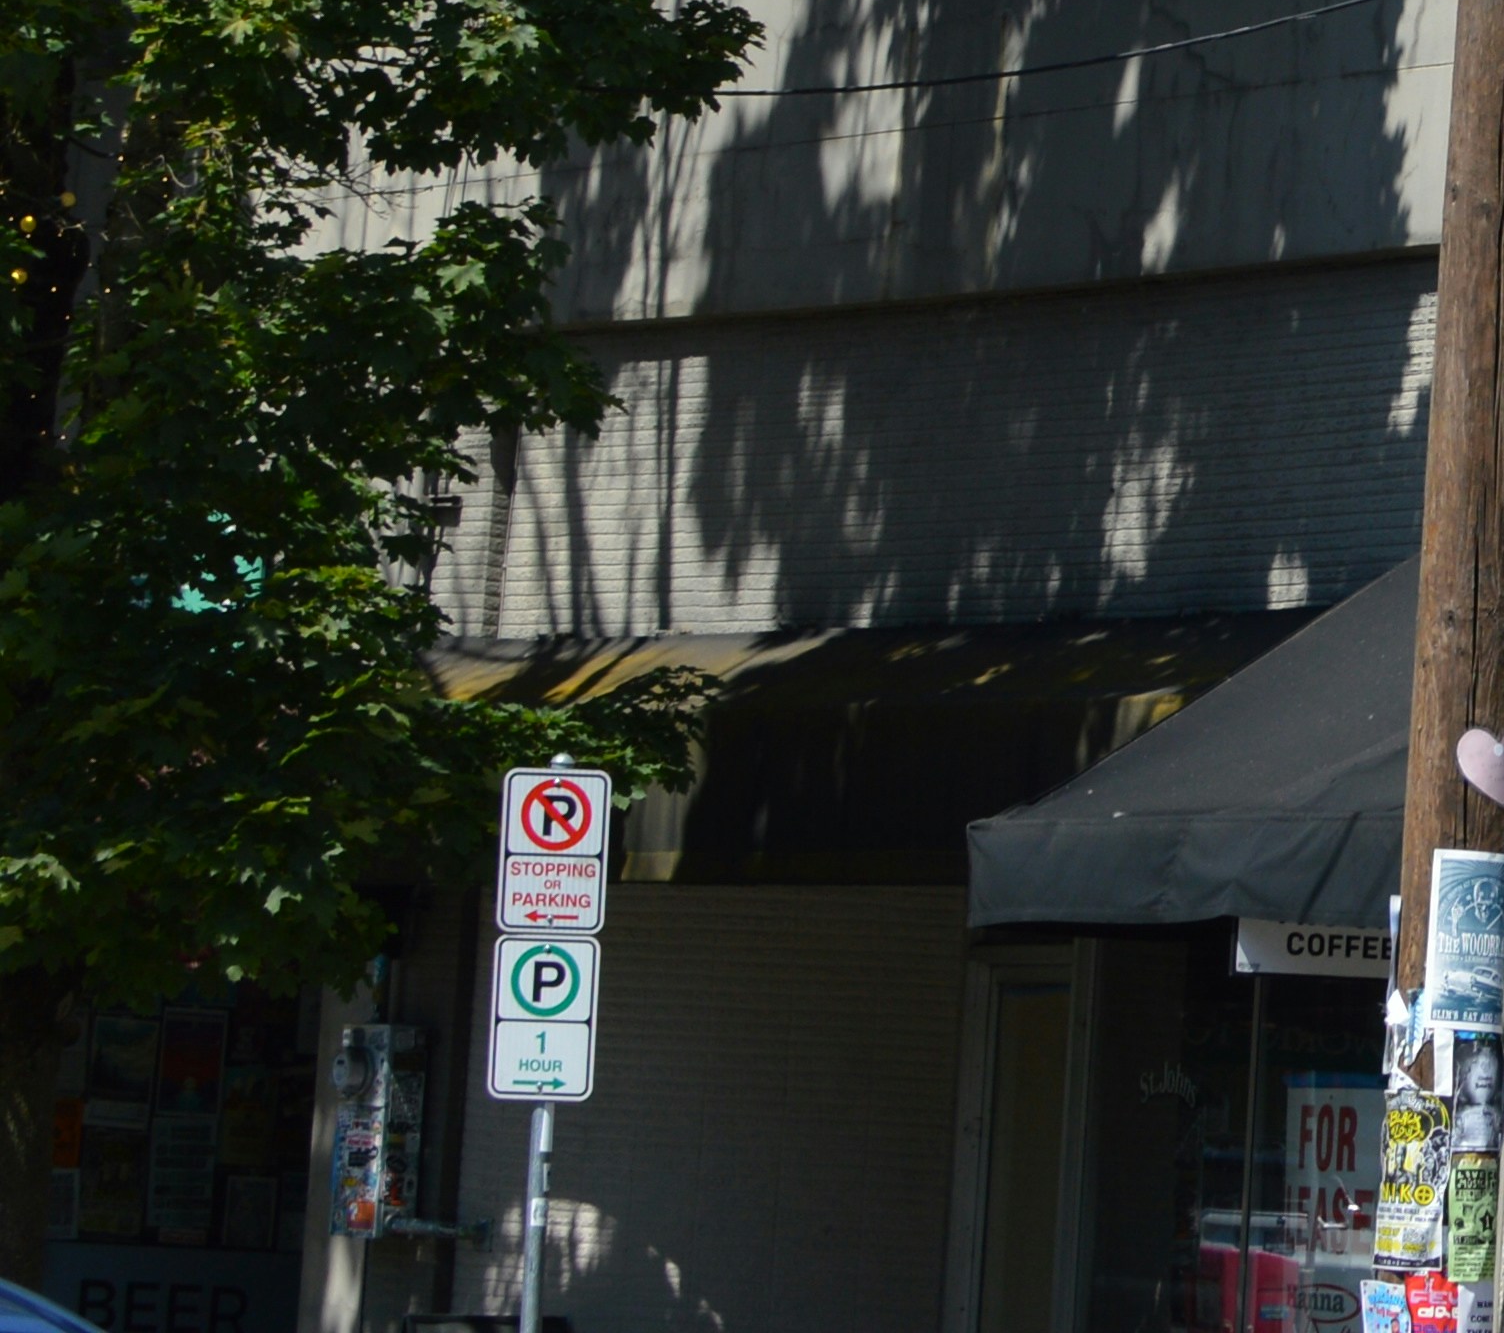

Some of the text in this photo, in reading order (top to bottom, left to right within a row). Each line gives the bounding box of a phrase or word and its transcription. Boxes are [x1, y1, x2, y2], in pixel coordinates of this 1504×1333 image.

[510, 861, 597, 879] STOPPING
[543, 879, 562, 890] OR
[511, 893, 592, 909] PARKING
[1286, 932, 1391, 960] COFFEE
[532, 960, 567, 1003] P
[535, 1030, 546, 1055] 1
[518, 1058, 563, 1073] HOUR
[1298, 1104, 1358, 1172] FOR
[1284, 1186, 1374, 1255] LEASE
[80, 1279, 248, 1333] BEER
